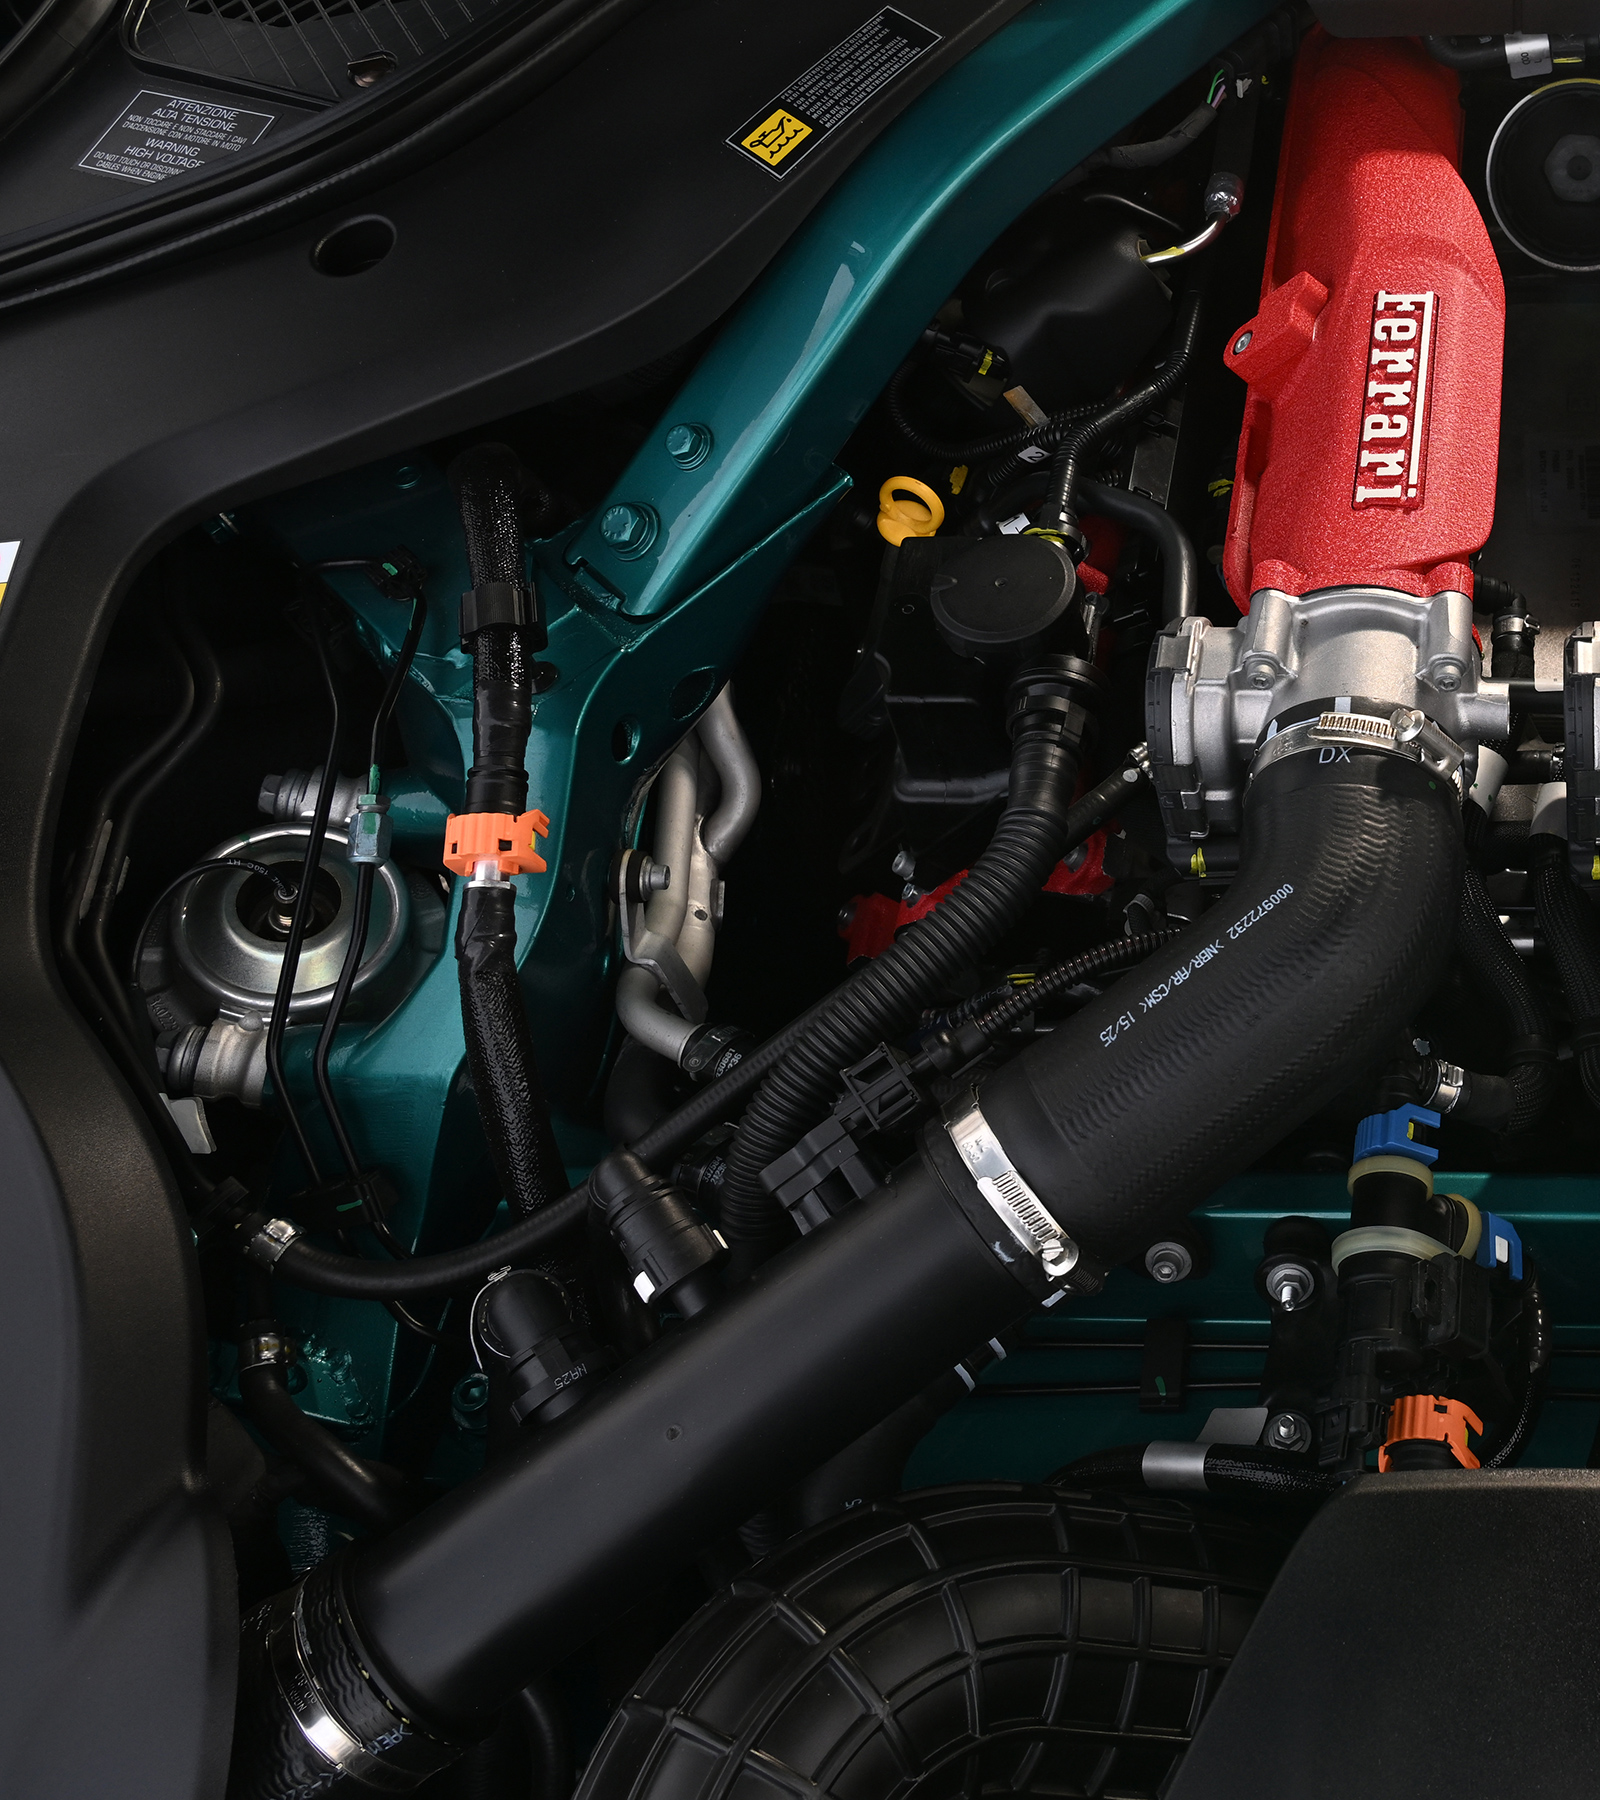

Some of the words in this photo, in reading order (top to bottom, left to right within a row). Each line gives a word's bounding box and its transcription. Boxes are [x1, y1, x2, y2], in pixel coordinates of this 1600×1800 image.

[151, 106, 179, 119] ALTA
[180, 112, 238, 132] TENSIONE
[166, 98, 239, 121] ATTENZIONE
[127, 114, 142, 122] NON
[143, 117, 172, 128] TOCCARE
[178, 124, 194, 133] NON
[194, 128, 227, 140] STACCARE
[231, 135, 247, 144] CAVI
[167, 130, 184, 139] CON
[183, 133, 211, 145] MOTORE
[219, 141, 241, 151] MOTO
[123, 145, 154, 159] HIGH
[144, 137, 201, 157] WARNING
[93, 150, 104, 159] DO
[104, 153, 118, 162] NOT
[117, 156, 141, 167] TOUCH
[140, 161, 150, 169] OR
[95, 159, 120, 170] CABLES
[120, 165, 142, 175] WHEN
[1353, 289, 1439, 510] Ferrari
[1318, 747, 1352, 764] DX
[1226, 883, 1294, 940] 000972232
[1138, 939, 1224, 1013] >NBR/AR/CSM<
[1099, 1010, 1136, 1048] 15/25
